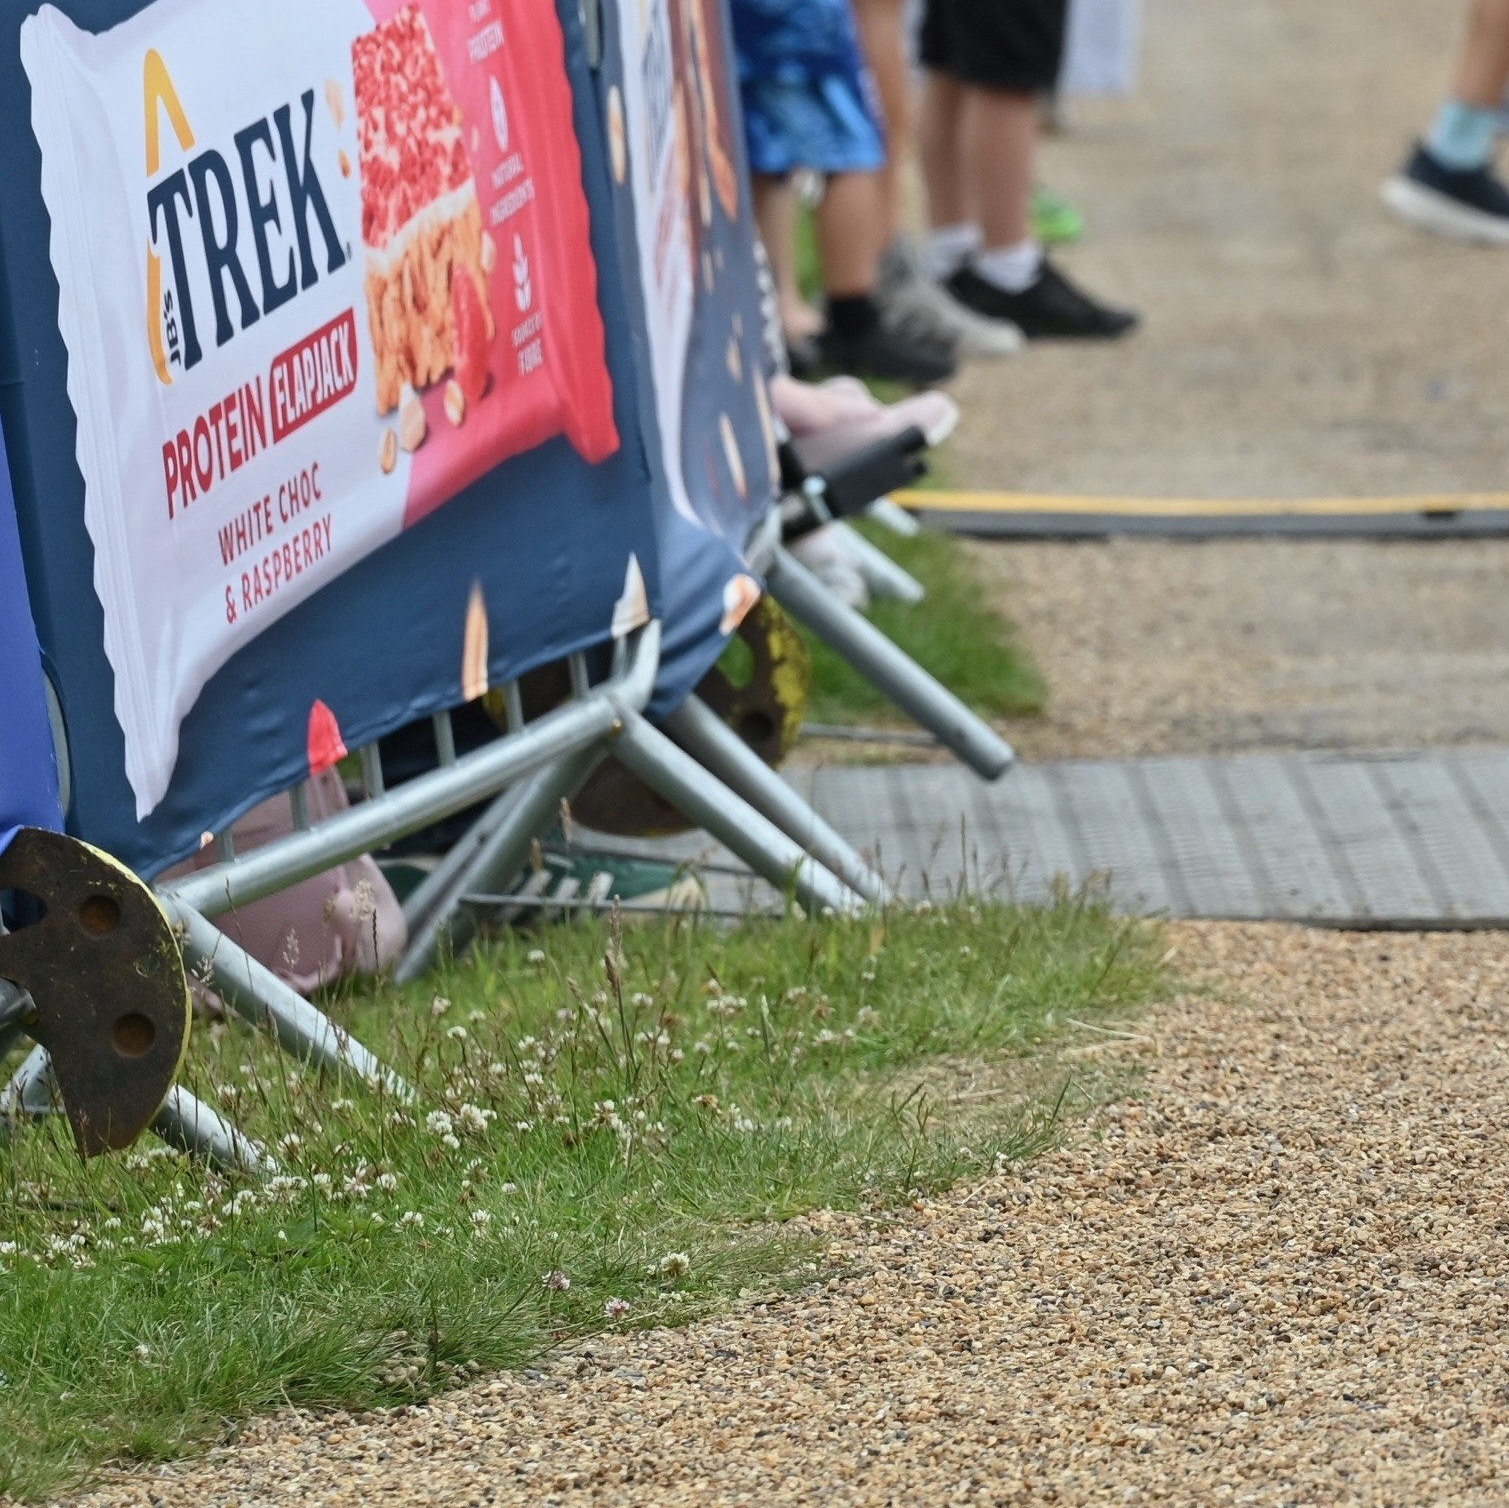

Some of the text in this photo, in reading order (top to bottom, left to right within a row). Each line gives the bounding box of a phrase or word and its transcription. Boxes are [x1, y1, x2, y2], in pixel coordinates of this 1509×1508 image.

[147, 88, 346, 371] TREK
[164, 289, 182, 367] JB'S
[162, 320, 355, 520] PROTEIN FLAPJACK
[218, 462, 321, 566] WHITE CHOC
[225, 513, 332, 624] & RASPBERRY
